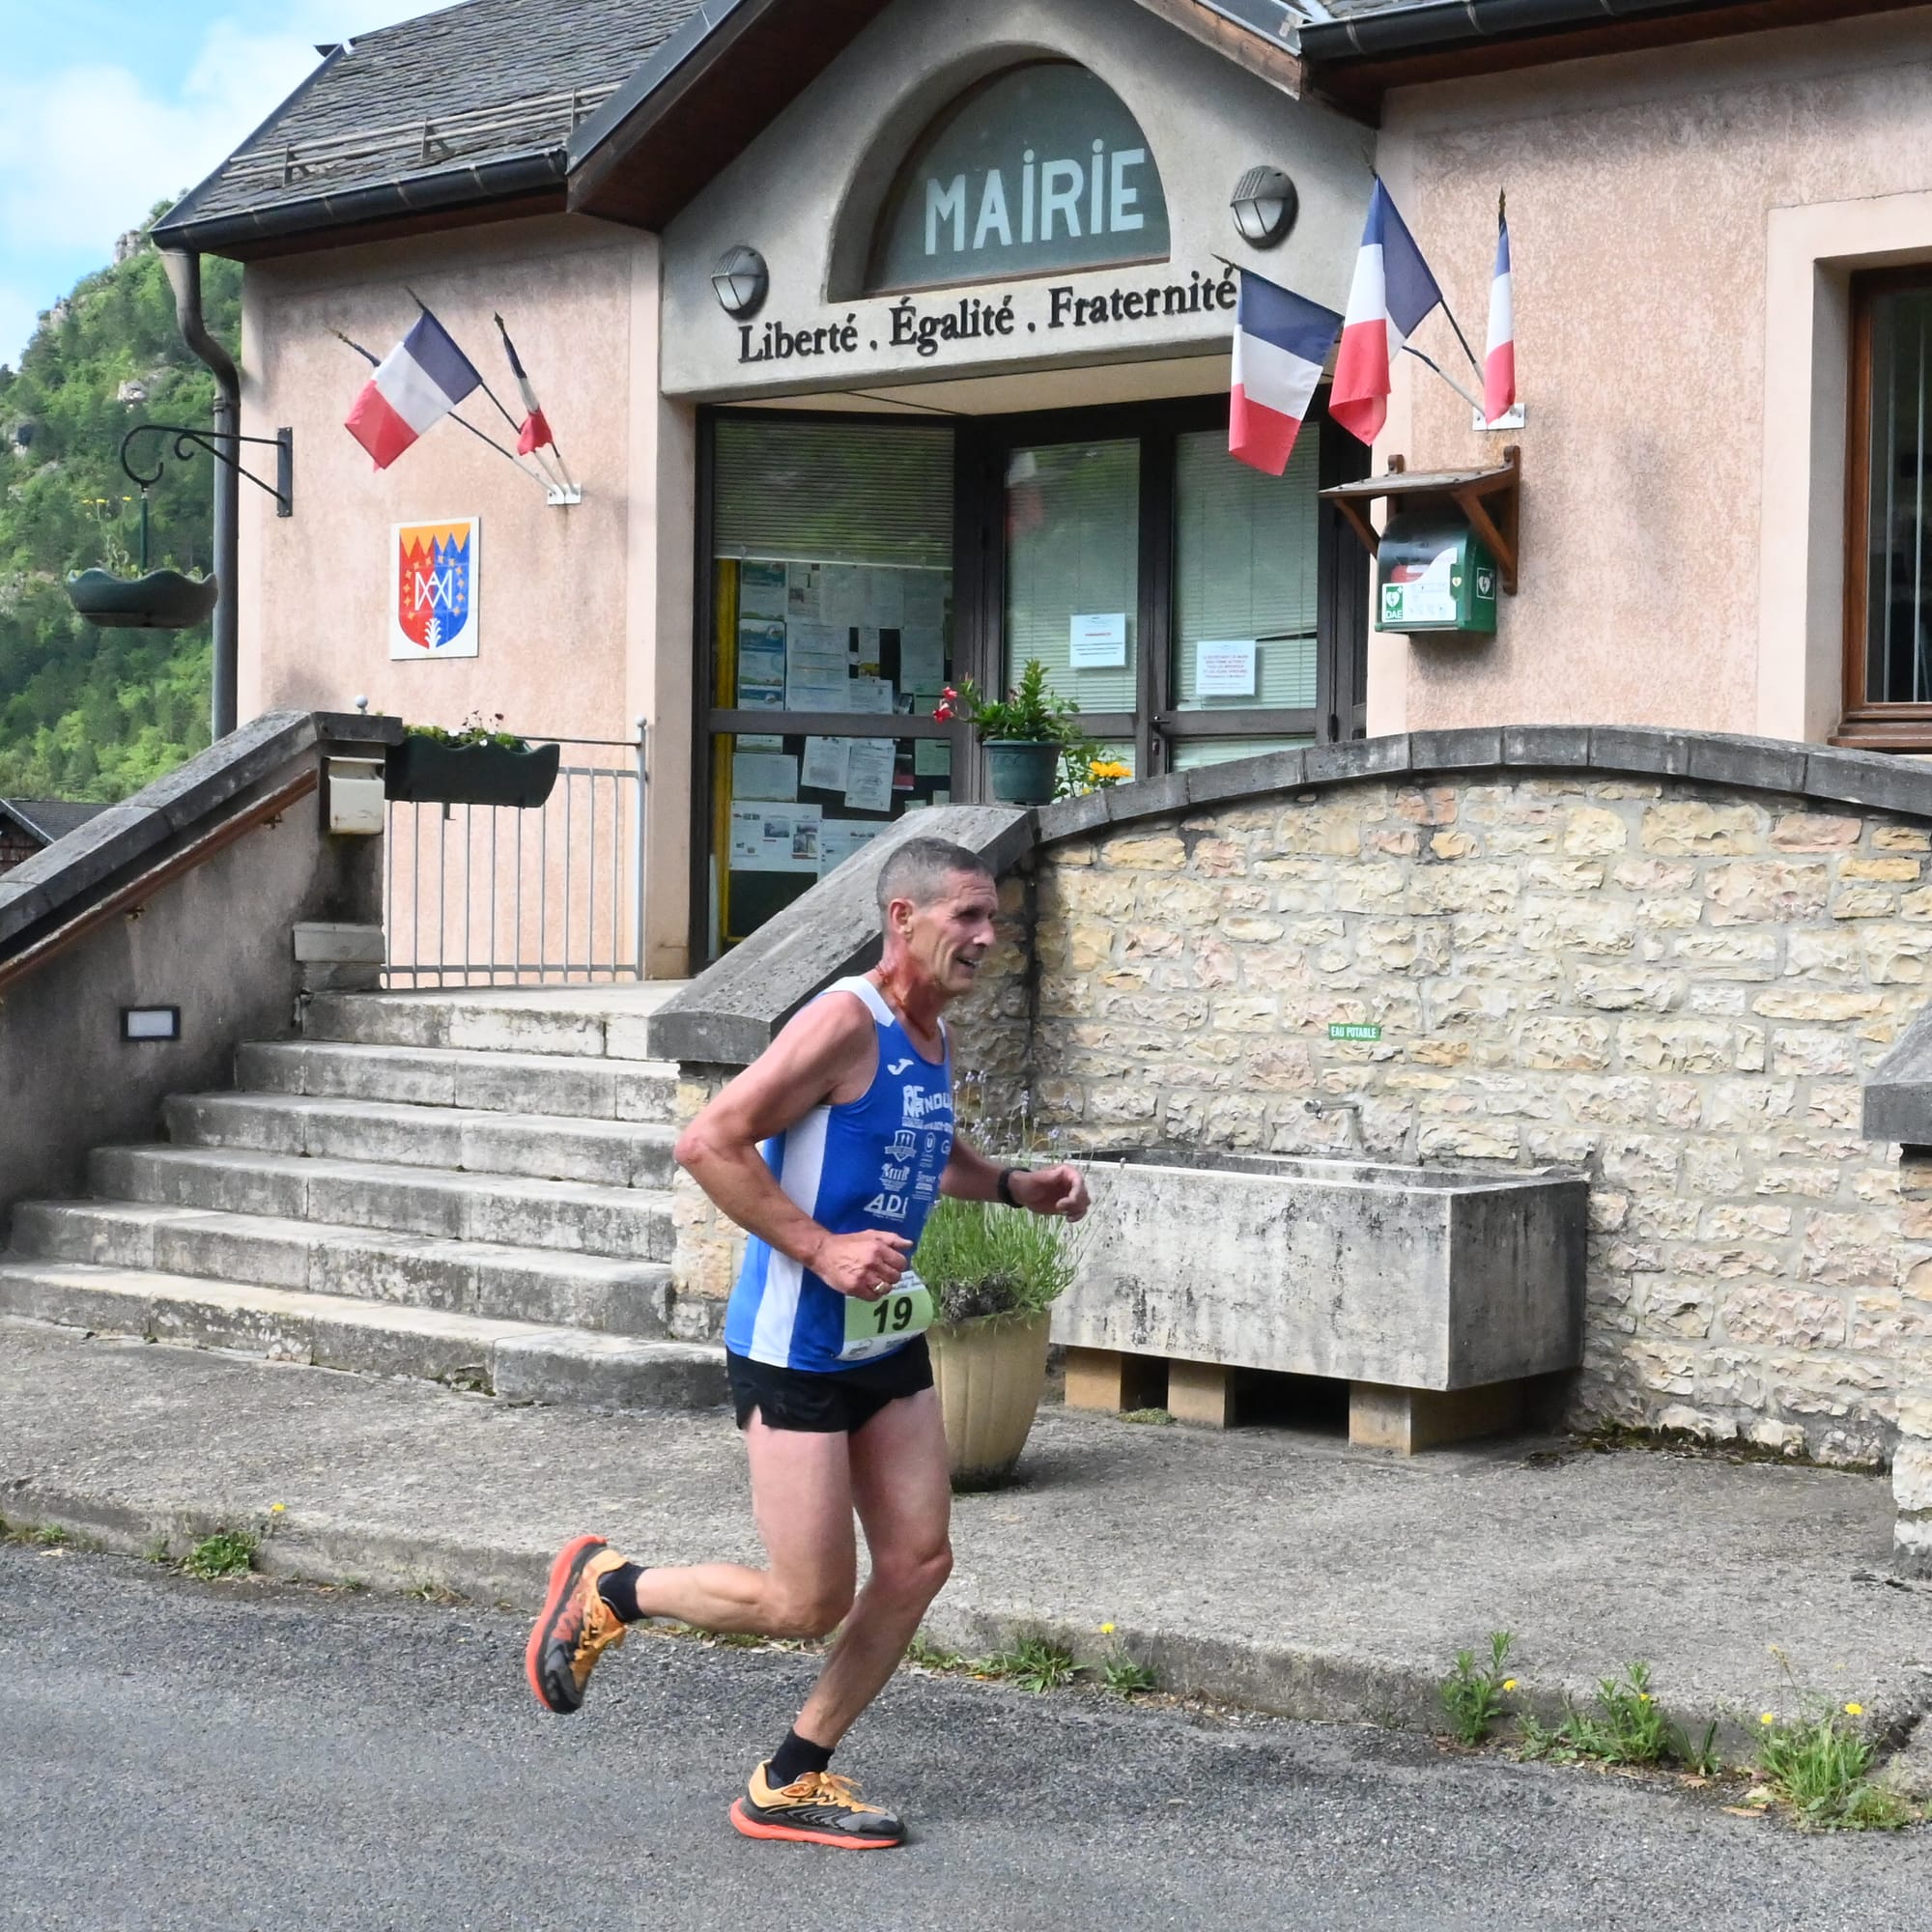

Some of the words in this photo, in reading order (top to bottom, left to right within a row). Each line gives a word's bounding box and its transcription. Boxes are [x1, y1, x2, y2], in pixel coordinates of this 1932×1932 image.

[738, 313, 859, 364] Liberté
[890, 294, 1015, 356] Égalité
[1048, 270, 1238, 330] Fraternité
[1385, 610, 1404, 619] DAE
[1331, 1026, 1345, 1037] EAU
[1347, 1027, 1377, 1038] POTABLE
[873, 1296, 913, 1334] 19
